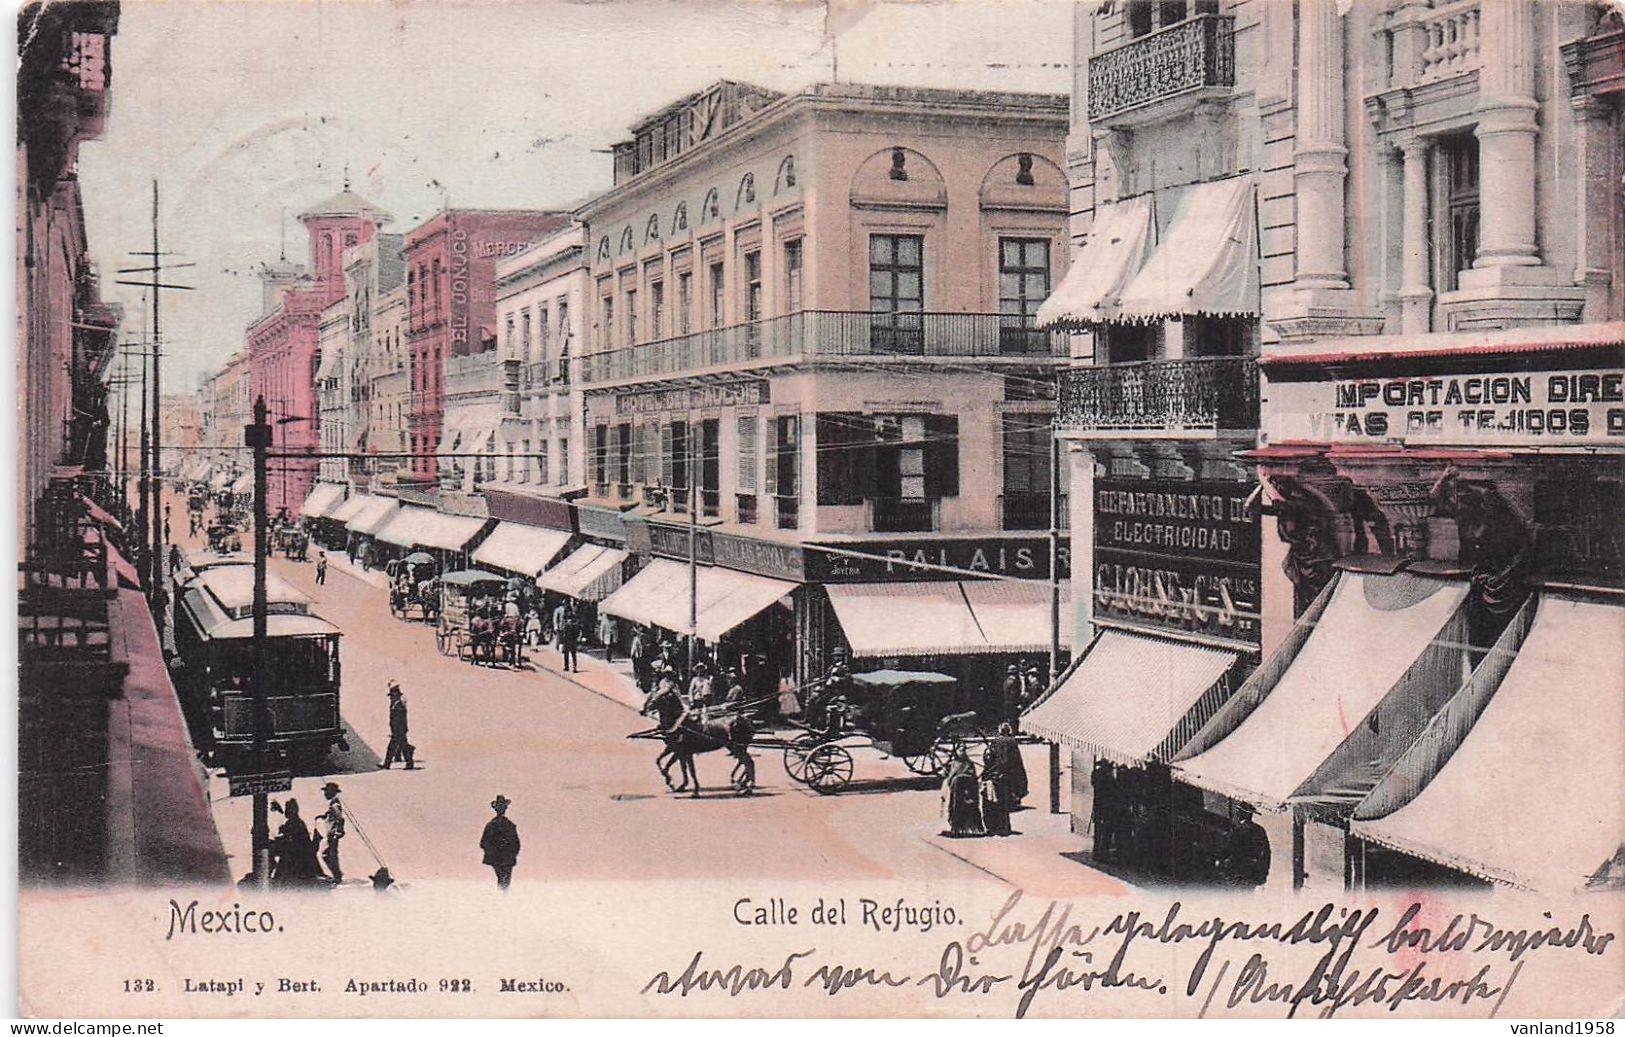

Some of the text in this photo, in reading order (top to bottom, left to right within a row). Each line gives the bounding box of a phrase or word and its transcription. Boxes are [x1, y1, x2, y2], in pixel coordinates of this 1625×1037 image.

[1335, 376, 1531, 408] IMPORTACION
[1458, 407, 1590, 436] TEJIDOS
[1098, 490, 1224, 521] DEPARTAMENTO
[1114, 520, 1232, 551] ELECTRICIDAD
[886, 547, 1034, 573] PALAIS
